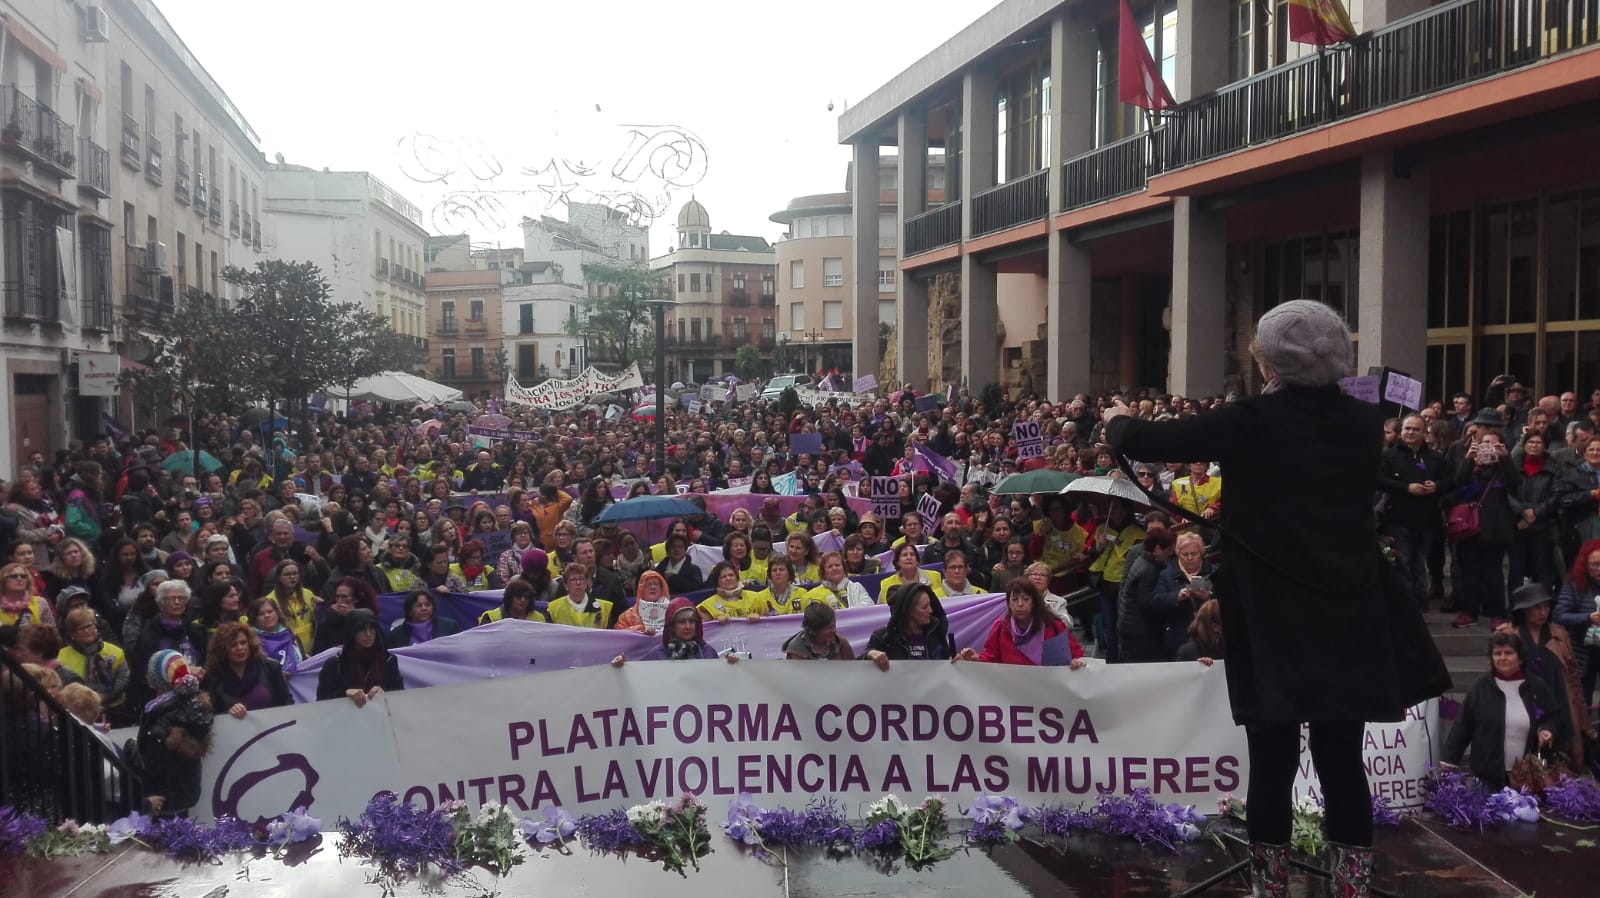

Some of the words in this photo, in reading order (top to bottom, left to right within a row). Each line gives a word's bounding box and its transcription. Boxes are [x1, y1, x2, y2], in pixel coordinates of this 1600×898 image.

[1016, 423, 1039, 440] NO
[1021, 445, 1042, 457] 416
[873, 479, 899, 495] NO
[874, 505, 897, 516] 416
[919, 496, 937, 519] NO
[508, 703, 802, 761] PLATAFORMA
[815, 703, 1099, 744] CORDOBESA
[1382, 728, 1407, 750] LA
[371, 769, 562, 813] ONTRA
[574, 759, 629, 804] LA
[635, 753, 870, 799] VIOLENCIA
[881, 754, 912, 792] A
[926, 754, 1010, 793] LAS
[1027, 755, 1240, 794] MUJERES
